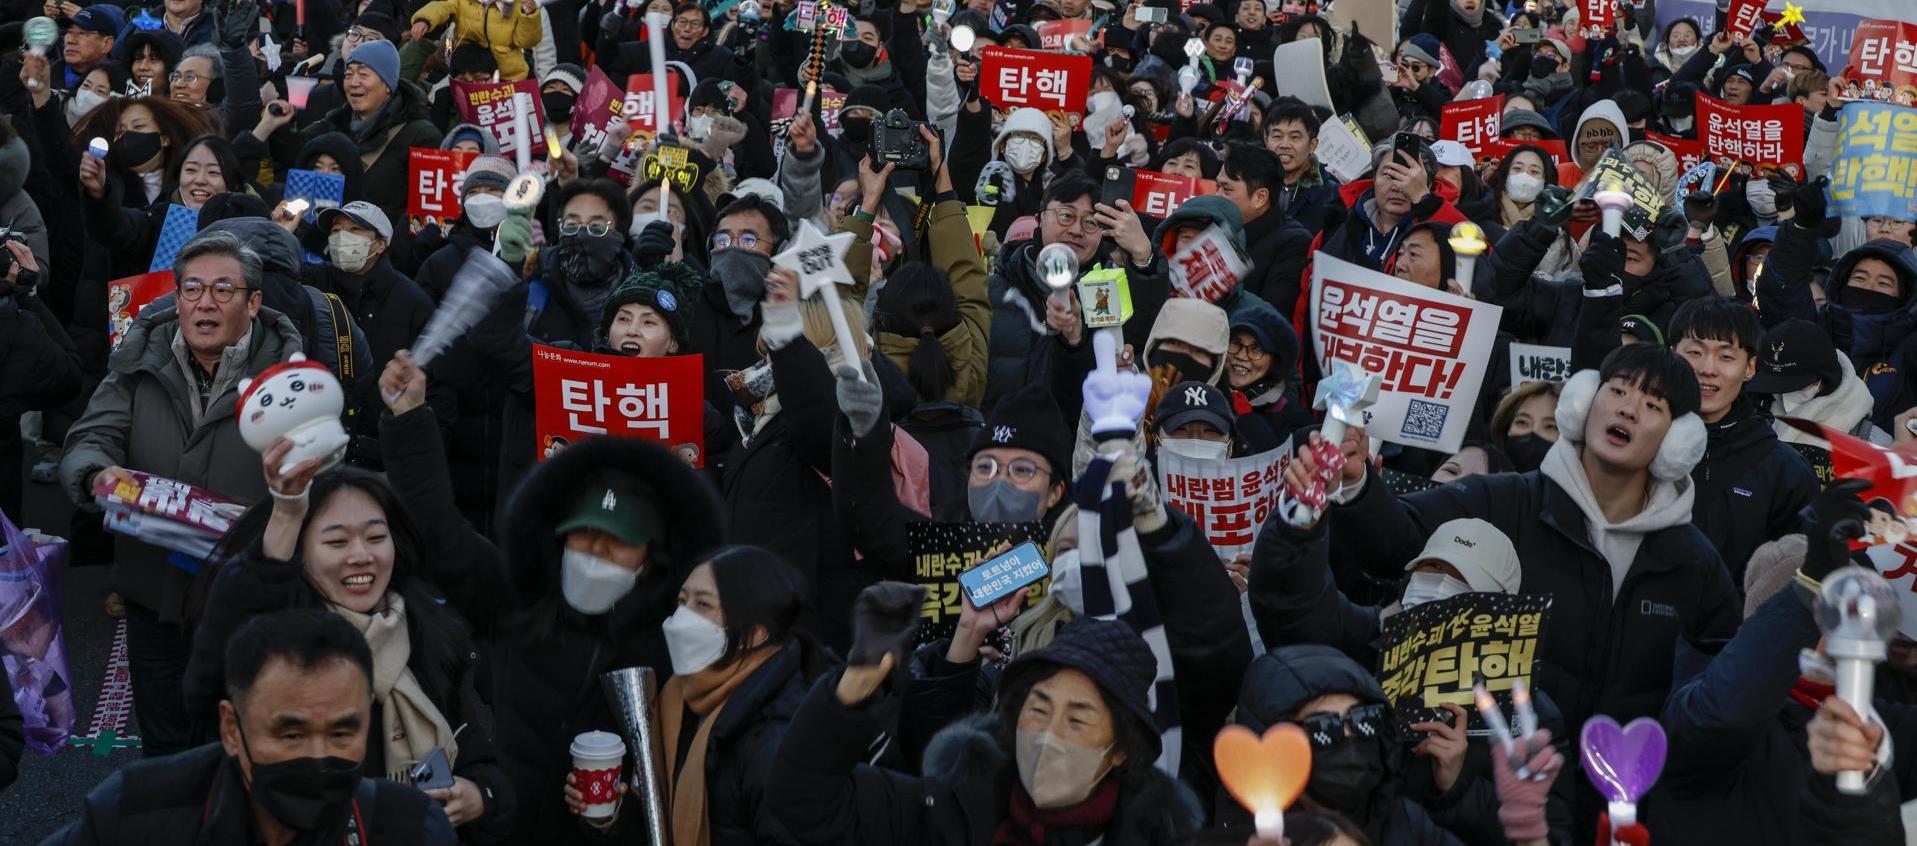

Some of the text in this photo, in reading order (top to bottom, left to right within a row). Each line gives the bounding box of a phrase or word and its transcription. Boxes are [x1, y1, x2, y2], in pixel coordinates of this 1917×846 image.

[999, 66, 1068, 107] 탄핵
[1708, 112, 1783, 141] 윤석열을
[1708, 134, 1784, 163] 탄핵하라
[803, 254, 834, 275] OUT
[1321, 285, 1460, 353] 윤석열을
[563, 357, 611, 368] www.nanum.com
[561, 379, 669, 439] 탄핵
[1185, 386, 1208, 406] NY
[1167, 473, 1234, 501] 내란범
[981, 555, 1021, 581] 토트넘아
[972, 576, 1013, 600] 대한민국
[1383, 612, 1541, 672] 내란수괴 윤석열
[1423, 638, 1537, 708] 탄핵
